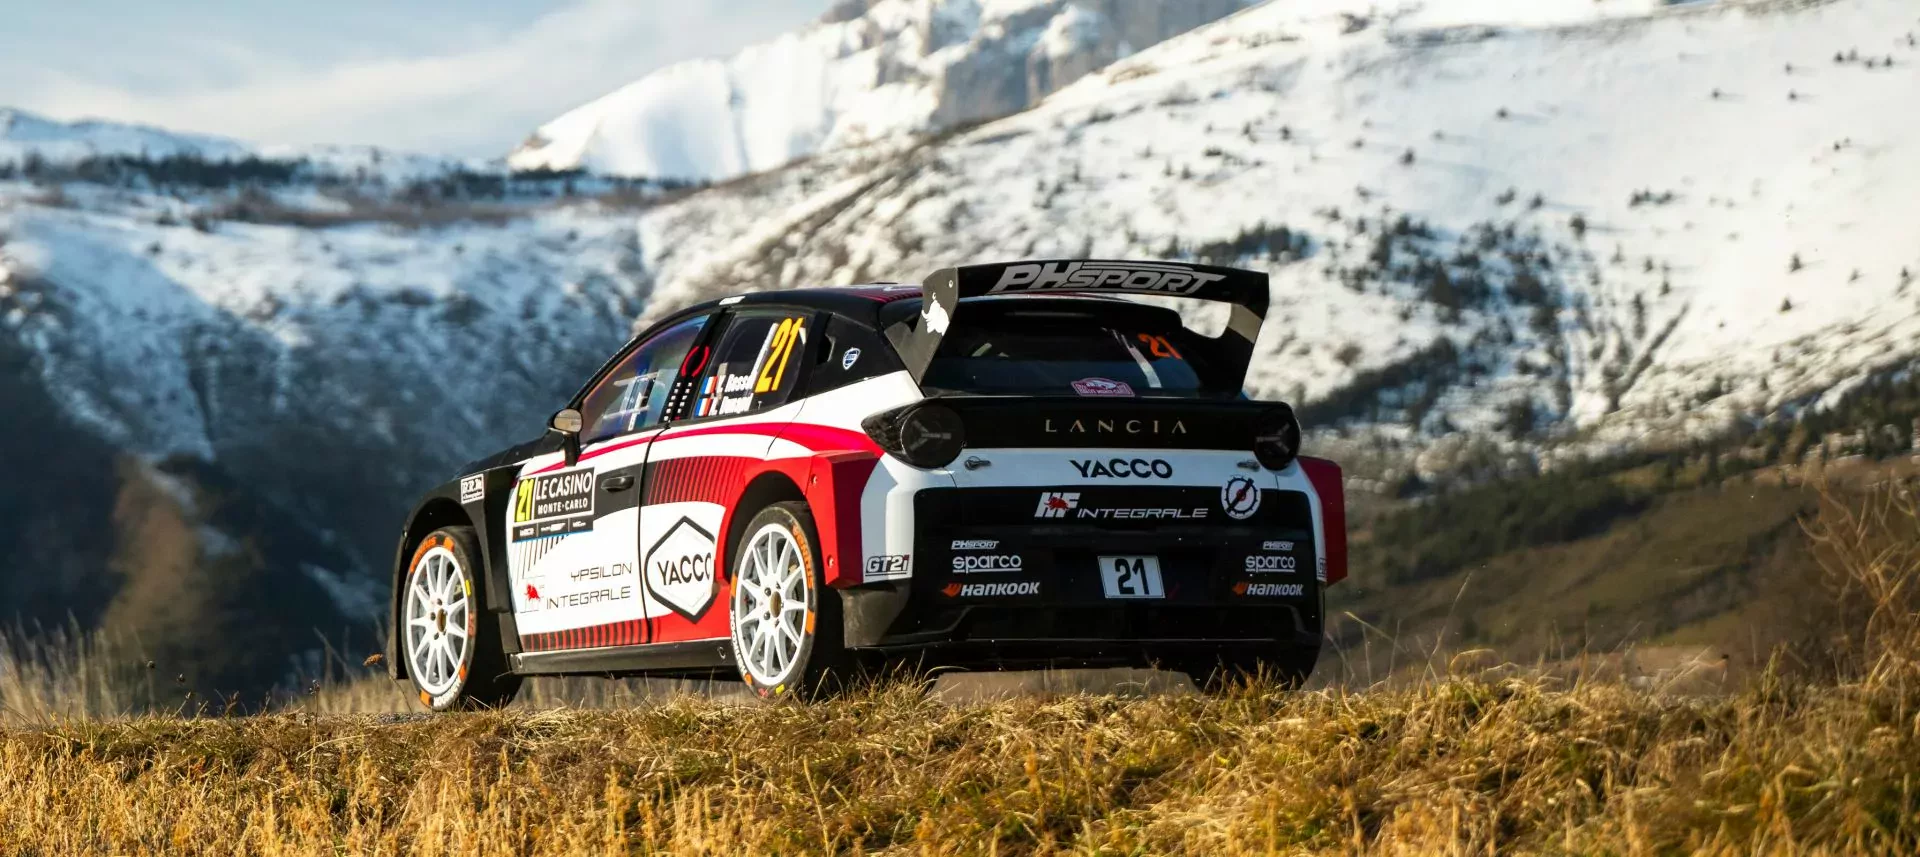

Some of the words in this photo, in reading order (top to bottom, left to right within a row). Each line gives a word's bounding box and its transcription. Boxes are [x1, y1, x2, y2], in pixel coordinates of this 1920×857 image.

[986, 261, 1228, 295] PHSPORT
[755, 317, 804, 393] 21
[1138, 333, 1183, 360] 21
[1044, 419, 1188, 434] LANCIA
[1069, 458, 1173, 479] YACCO
[535, 478, 548, 501] LE
[548, 471, 593, 499] CASINO
[515, 478, 535, 523] 21
[1077, 507, 1209, 518] INTEGRALE
[570, 562, 633, 582] YPSILON
[865, 554, 910, 575] GT2i
[952, 555, 1022, 574] sparco
[1245, 555, 1296, 573] sparco
[1114, 558, 1150, 595] 21
[546, 586, 631, 610] INTEGRALE
